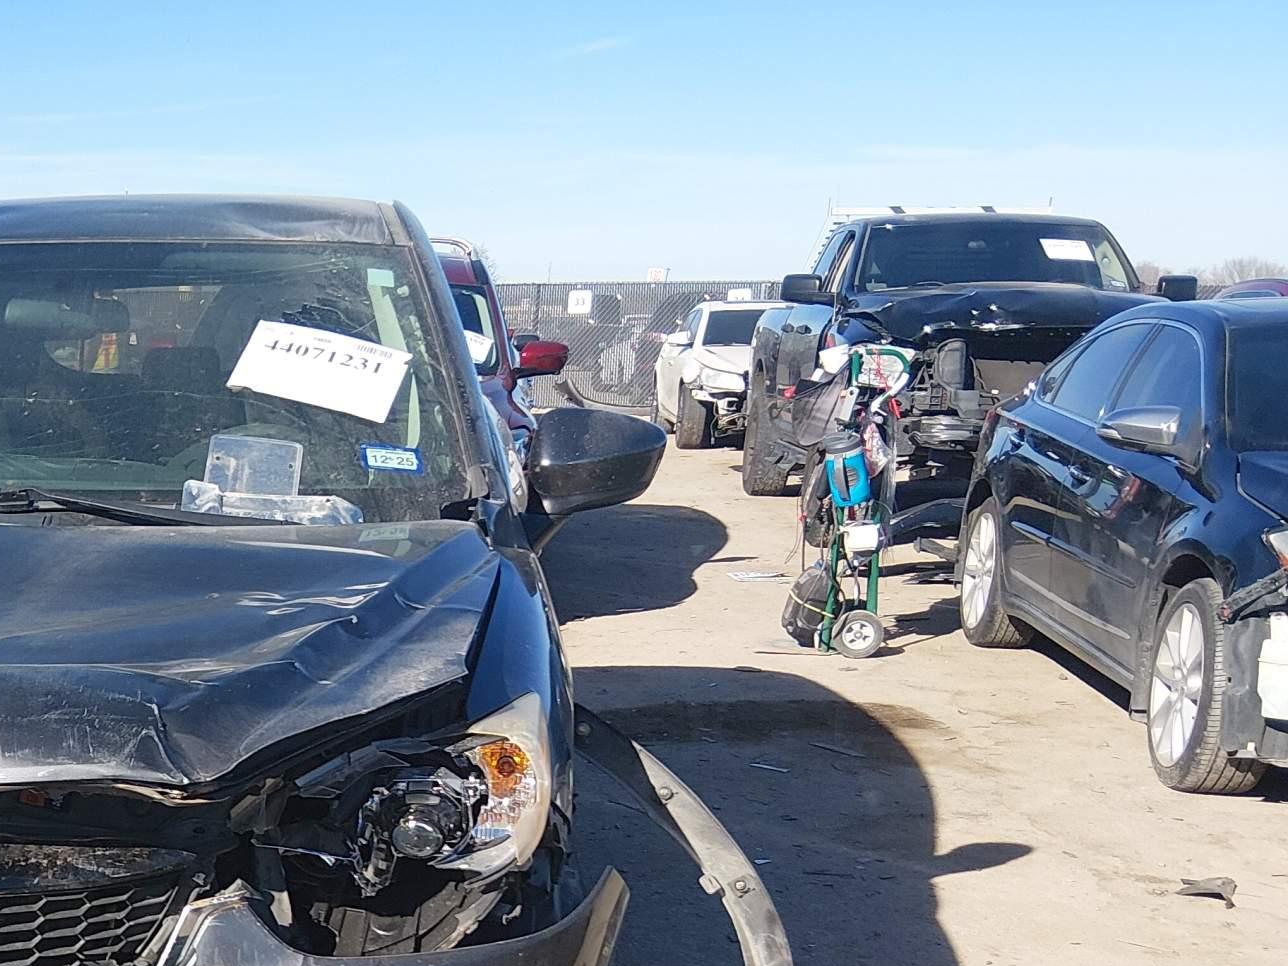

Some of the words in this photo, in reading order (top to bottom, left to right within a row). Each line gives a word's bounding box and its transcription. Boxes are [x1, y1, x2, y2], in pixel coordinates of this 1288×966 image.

[264, 339, 385, 374] 44071231
[371, 454, 389, 464] 12
[396, 456, 415, 467] 25
